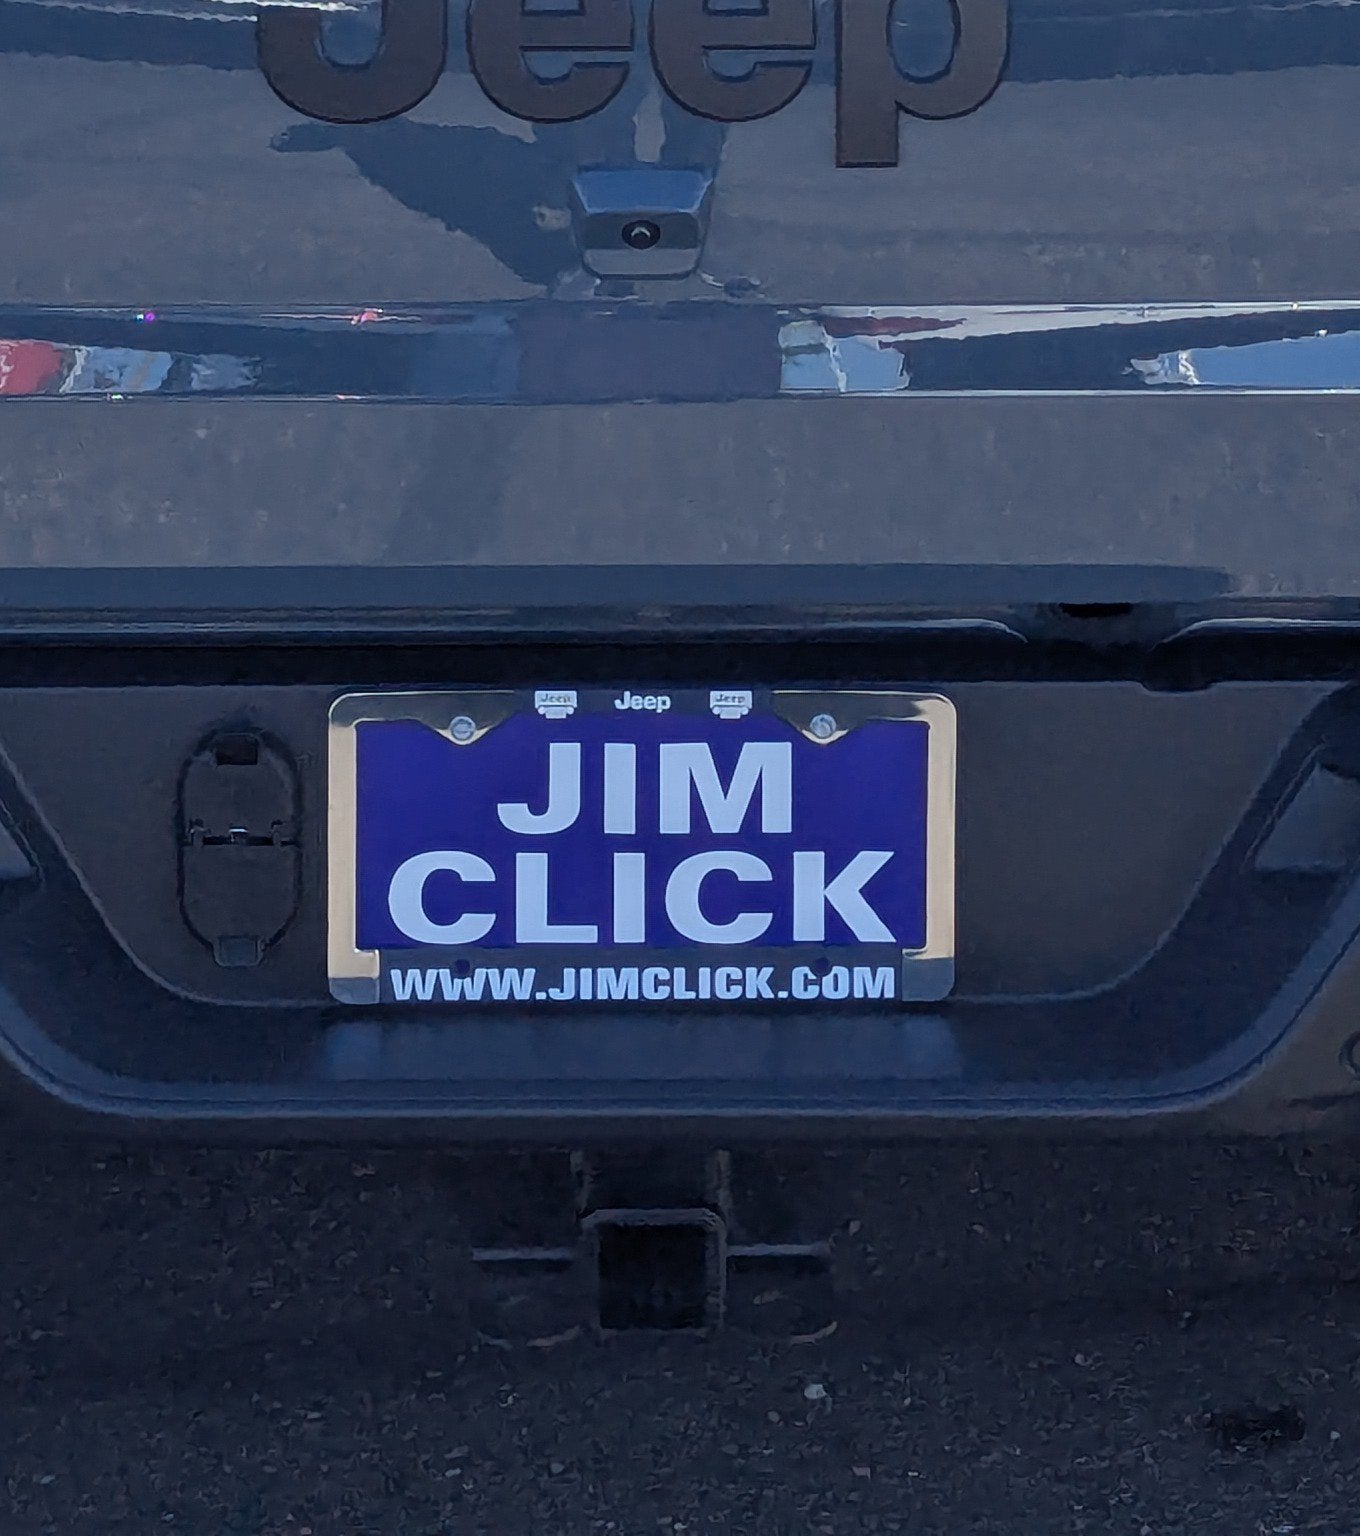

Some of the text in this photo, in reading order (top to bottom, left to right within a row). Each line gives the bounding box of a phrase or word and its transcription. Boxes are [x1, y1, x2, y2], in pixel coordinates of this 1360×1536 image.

[614, 690, 671, 713] Jeep
[497, 741, 792, 835] JIM
[388, 850, 897, 945] CLICK
[390, 965, 896, 1002] WWW.JIMCLICK.COM
